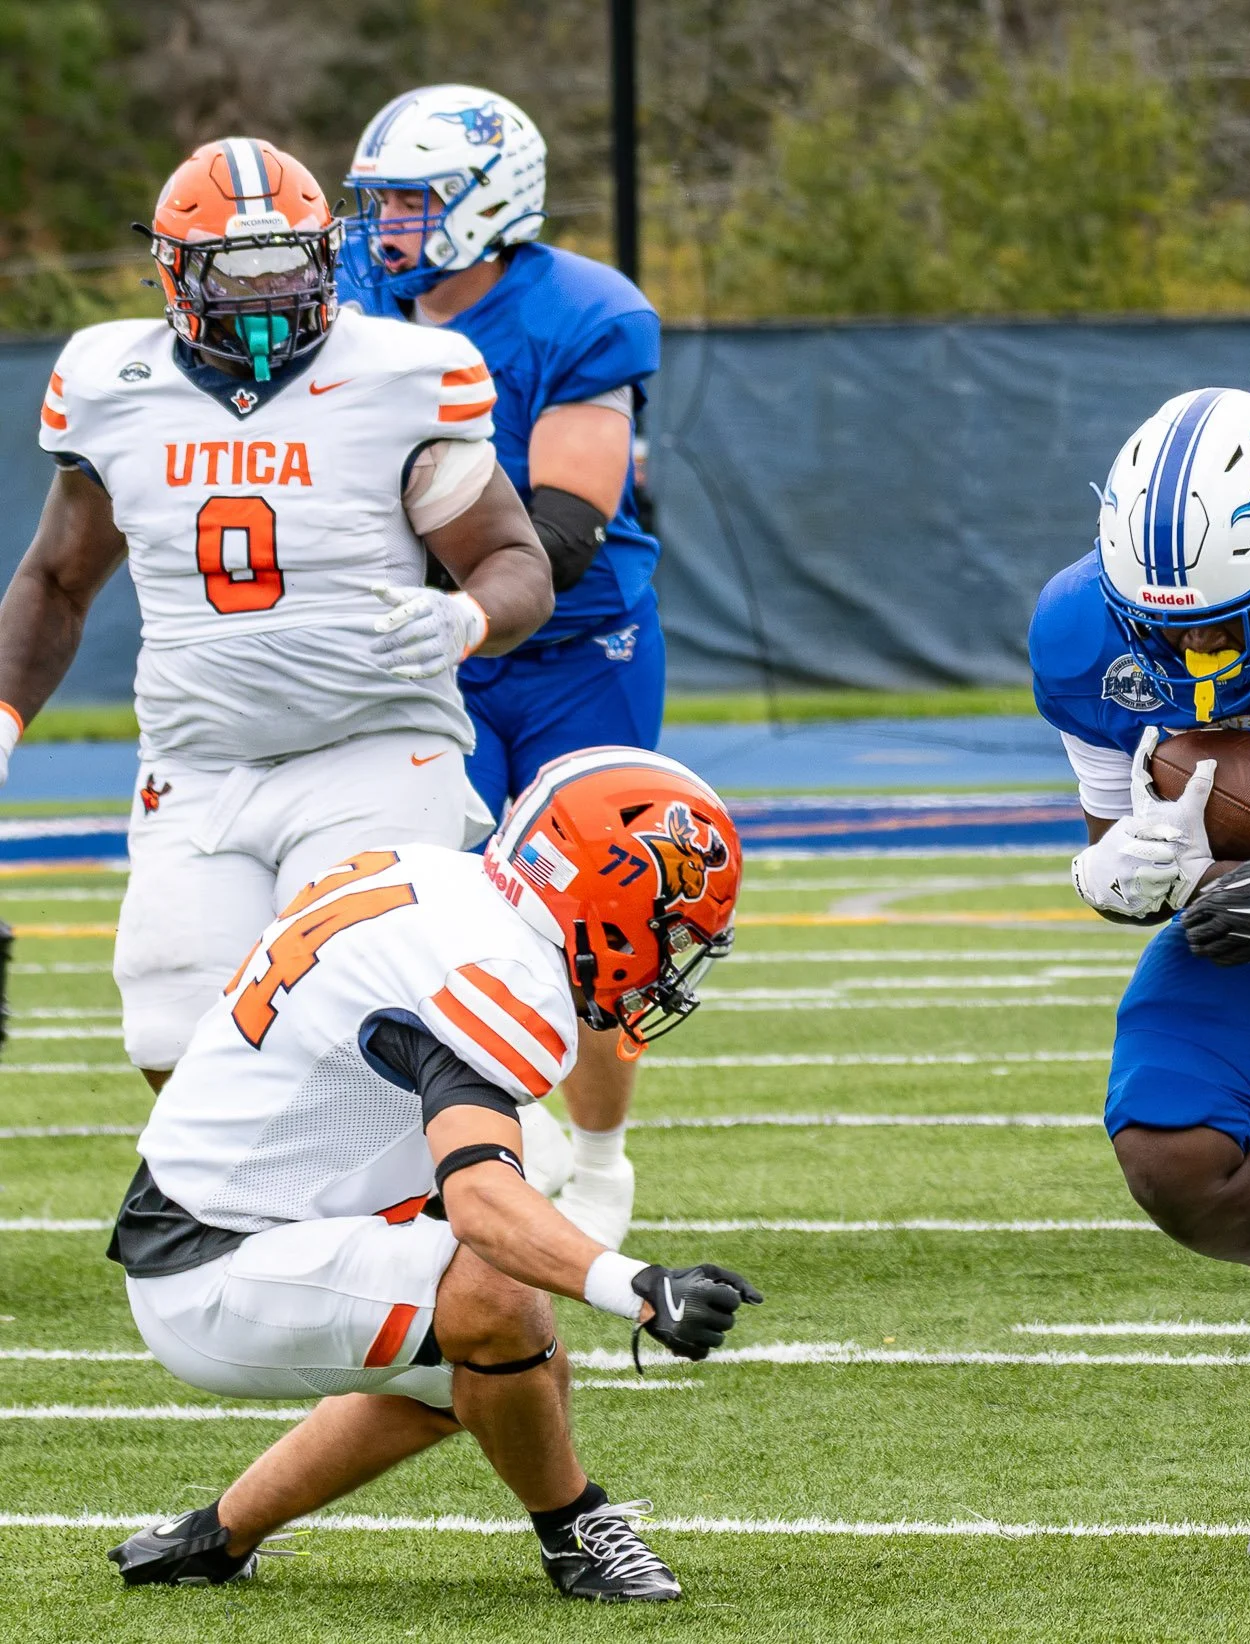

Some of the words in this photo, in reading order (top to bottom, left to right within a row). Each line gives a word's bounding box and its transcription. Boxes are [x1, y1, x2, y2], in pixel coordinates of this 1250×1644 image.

[164, 441, 313, 488] UTICA
[195, 495, 286, 615] 0
[1142, 591, 1195, 606] Riddell
[598, 844, 650, 888] 77
